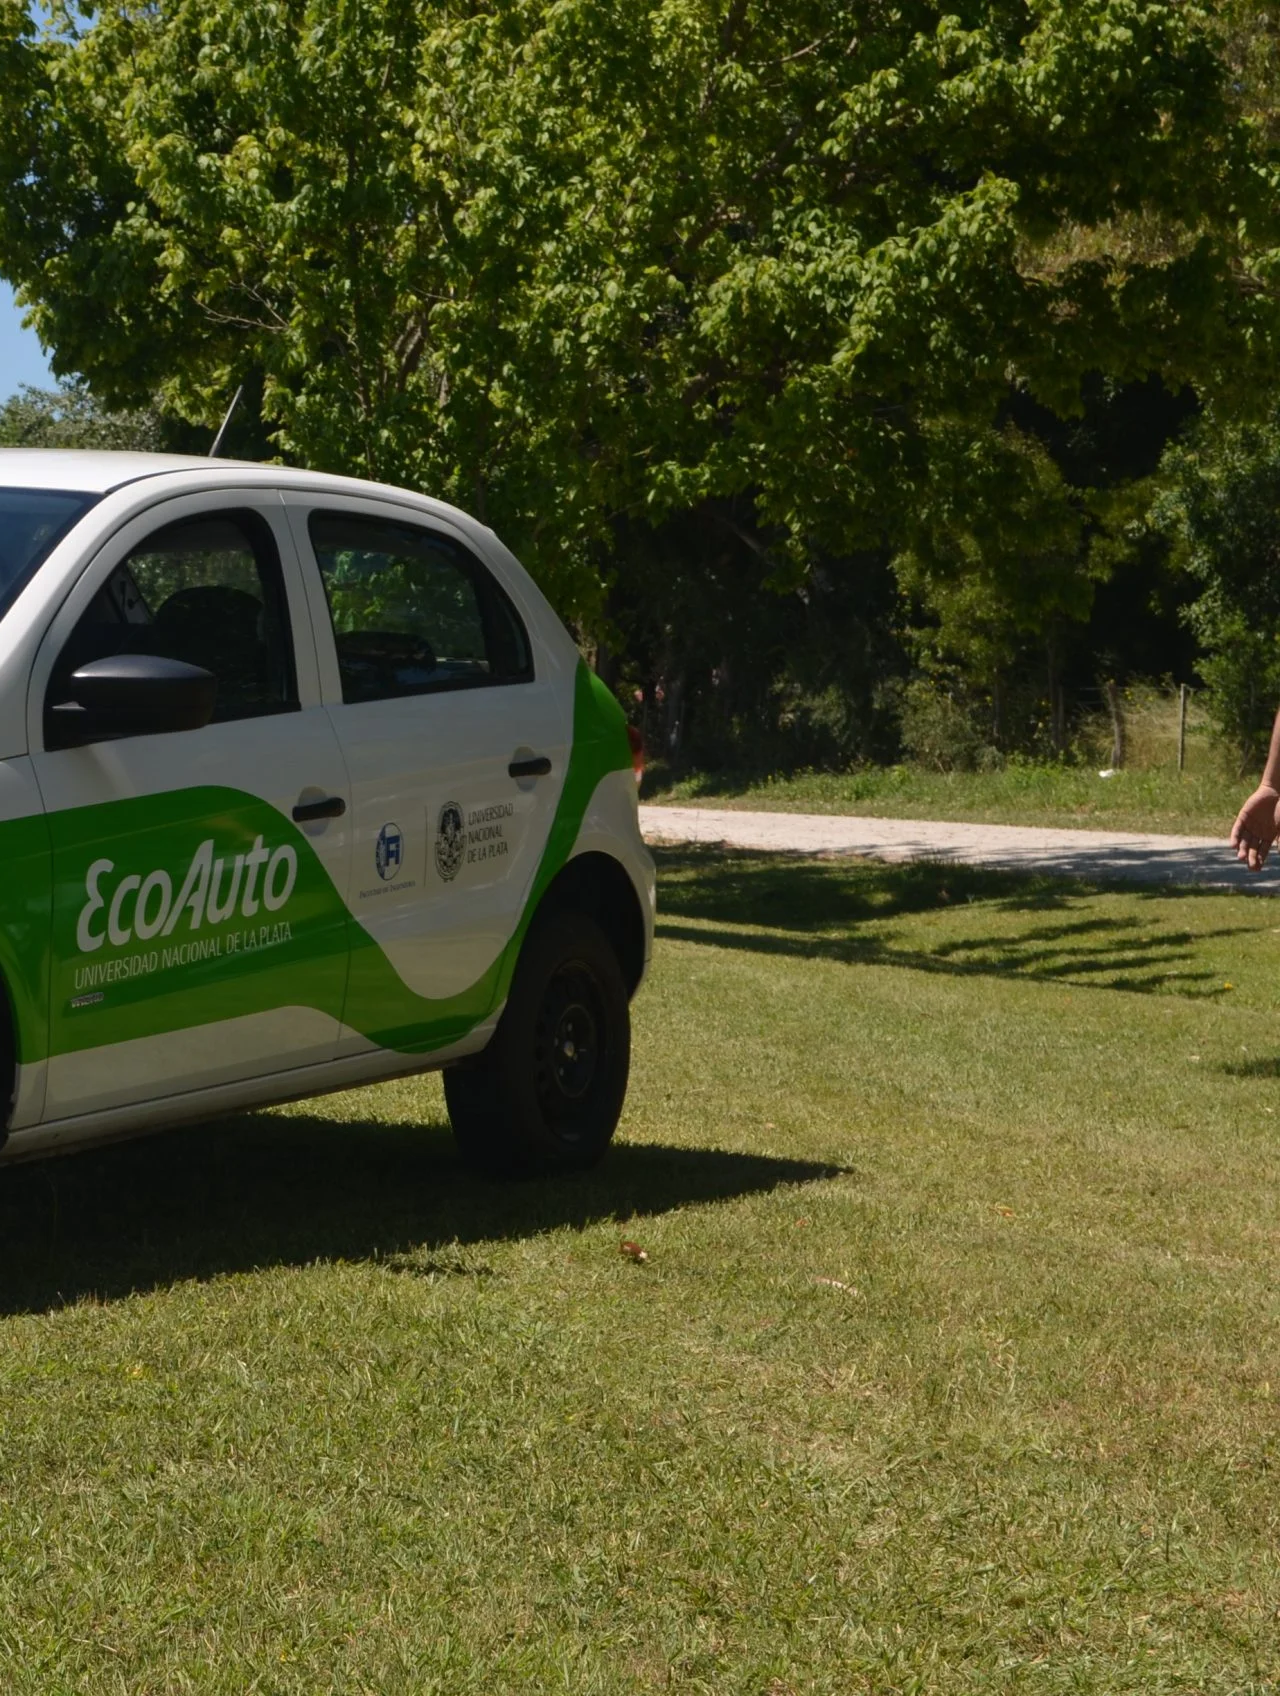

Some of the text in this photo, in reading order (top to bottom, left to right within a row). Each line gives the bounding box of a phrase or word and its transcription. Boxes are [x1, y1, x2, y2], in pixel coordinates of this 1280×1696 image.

[468, 803, 514, 826] UNIVERSIDAD
[468, 824, 504, 845] NACIONAL
[467, 841, 509, 864] DE LA PLATA
[76, 834, 298, 952] EcoAuto
[74, 921, 293, 990] UNIVERSIDAD NACIONAL DE LA PLATA
